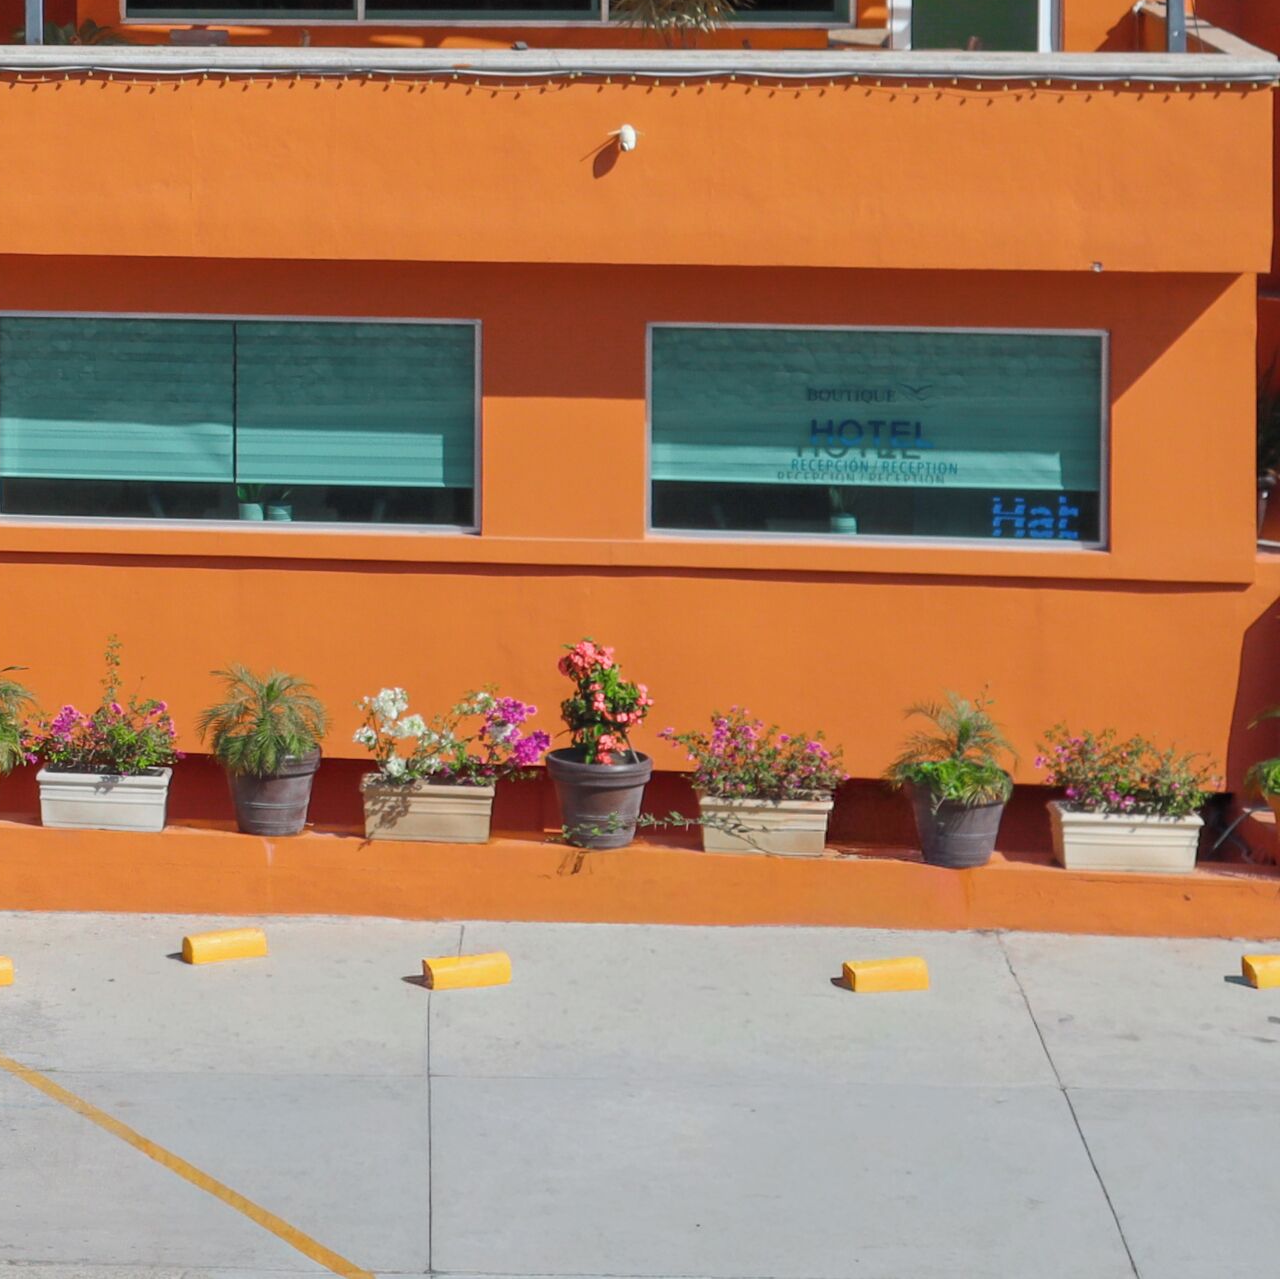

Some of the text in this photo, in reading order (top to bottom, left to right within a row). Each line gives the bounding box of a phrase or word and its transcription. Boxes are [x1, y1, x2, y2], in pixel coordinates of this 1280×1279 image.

[807, 388, 896, 404] BOUTIQUE
[809, 419, 935, 448] HOTEL
[790, 457, 869, 474] RECEPCIÓN
[881, 461, 958, 475] RECEPTION
